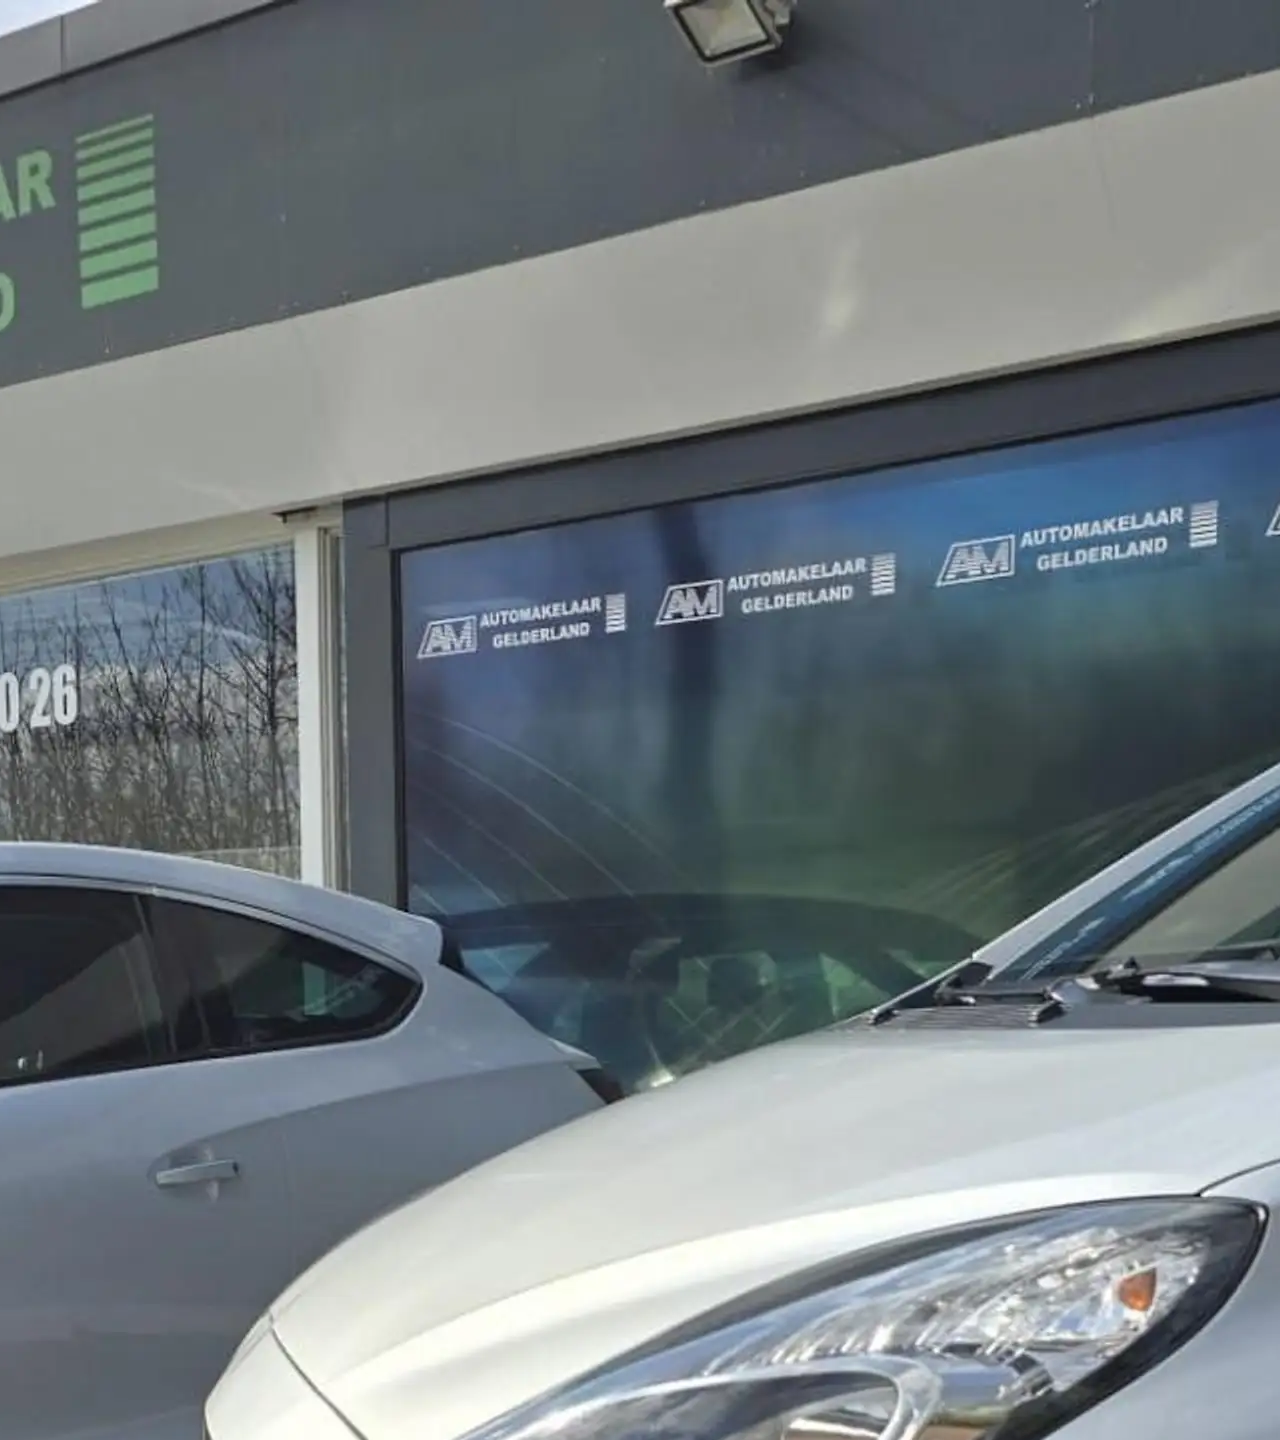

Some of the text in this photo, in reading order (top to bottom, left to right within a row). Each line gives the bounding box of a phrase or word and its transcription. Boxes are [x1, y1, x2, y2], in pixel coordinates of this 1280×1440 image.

[1020, 506, 1184, 548] AUTOMAKELAAR
[1037, 536, 1167, 571] GELDERLAND
[727, 557, 867, 592] AUTOMAKELAAR
[479, 596, 601, 629] AUTOMAKELAAR
[741, 585, 853, 614] GELDERLAND
[492, 622, 590, 649] GELDERLAND
[29, 664, 78, 729] 26
